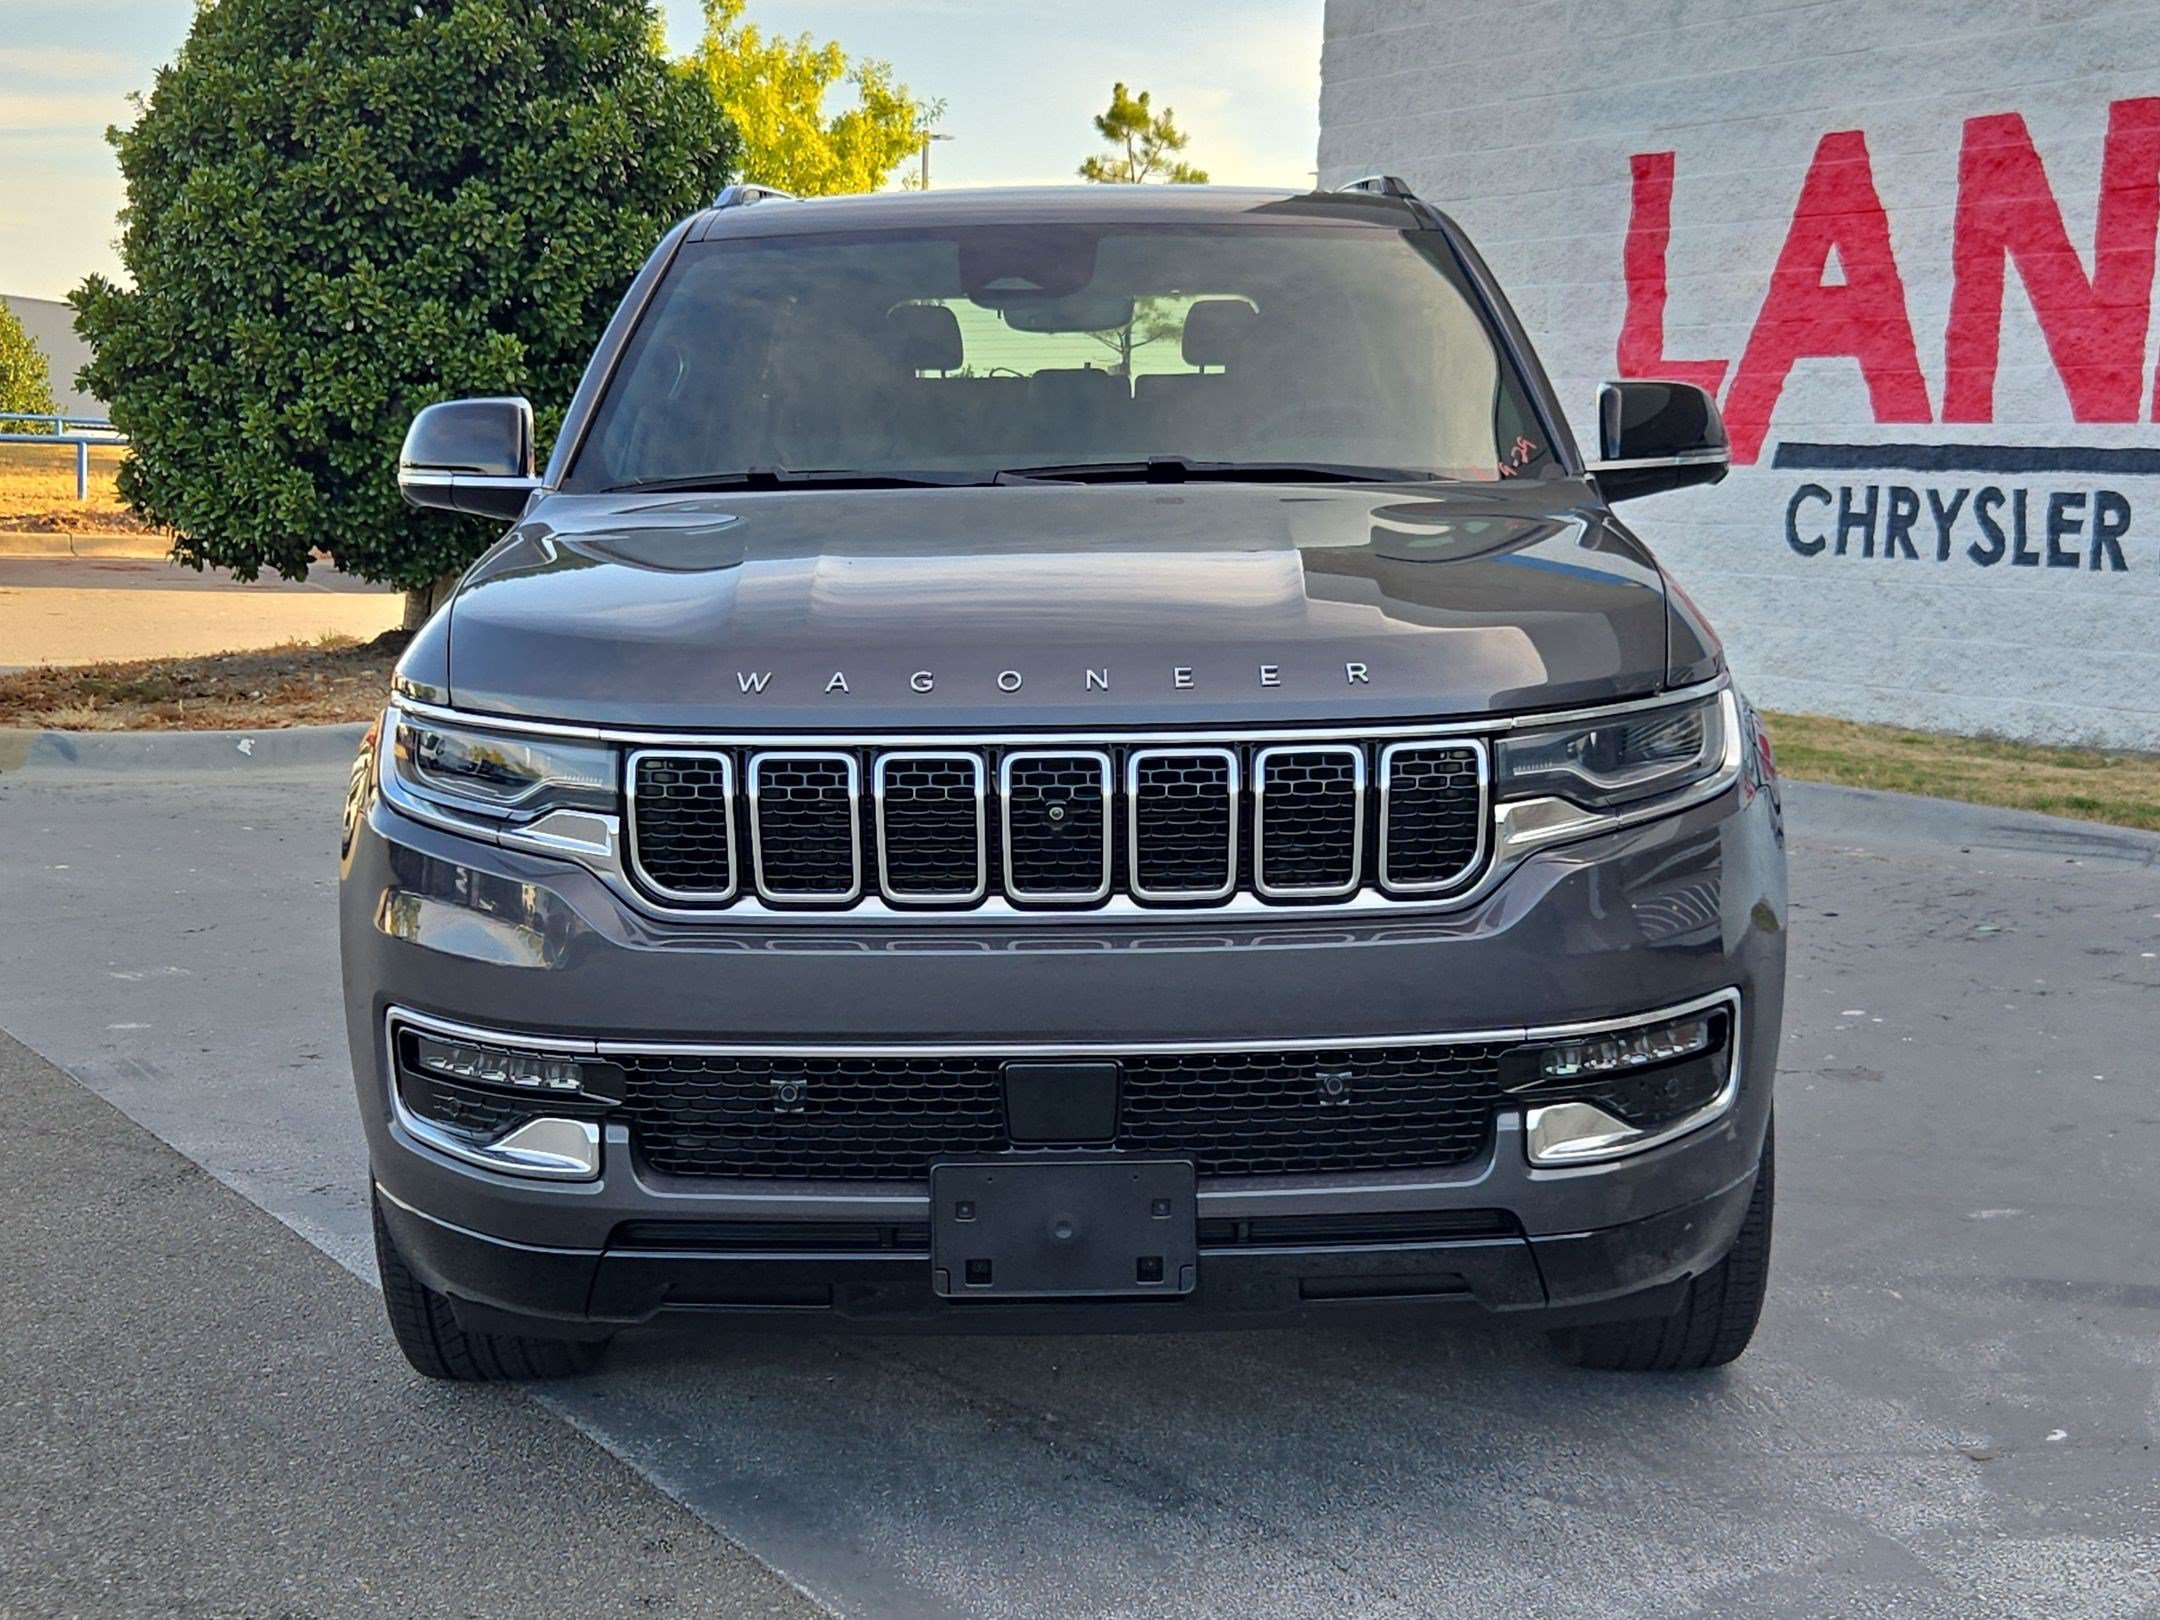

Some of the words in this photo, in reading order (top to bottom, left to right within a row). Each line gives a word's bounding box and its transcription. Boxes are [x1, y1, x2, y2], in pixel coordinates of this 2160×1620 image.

[1616, 96, 2160, 465] LAN
[1784, 483, 2132, 572] CHRYSLER
[736, 662, 1370, 693] WAGONEER
